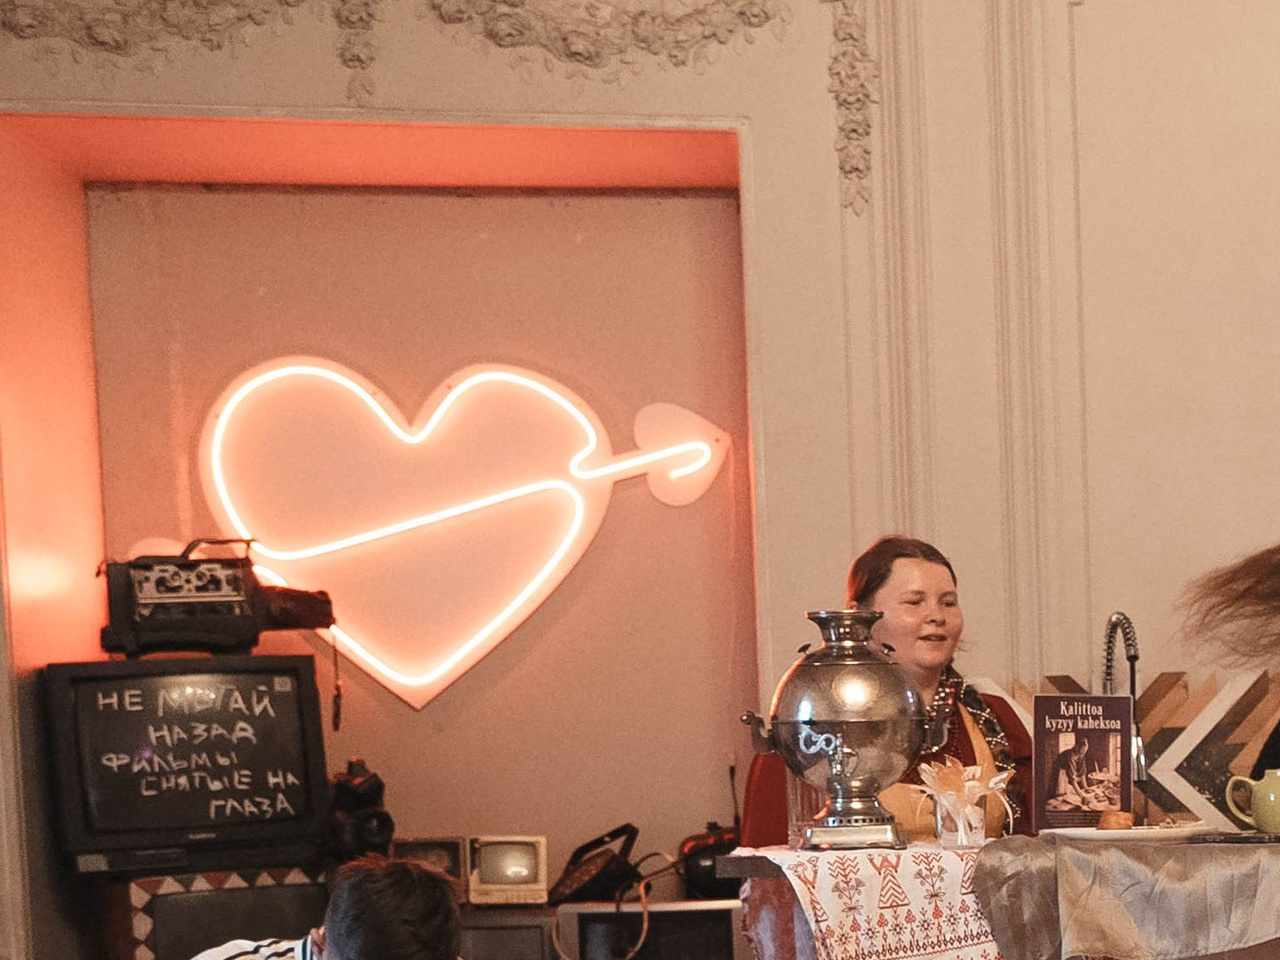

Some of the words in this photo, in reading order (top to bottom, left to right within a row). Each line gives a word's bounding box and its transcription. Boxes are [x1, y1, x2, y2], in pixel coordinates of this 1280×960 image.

[97, 689, 143, 711] НЕ
[1060, 701, 1103, 716] Kalittoa
[148, 720, 257, 747] НАЗАД
[1045, 715, 1074, 732] kyzyy
[1077, 715, 1121, 729] kaheksoa
[101, 751, 239, 774] ФИЛЬМЫ
[141, 770, 252, 796] СНЯТЫЕ
[267, 768, 300, 789] НА
[209, 792, 295, 820] ГЛАЗА
